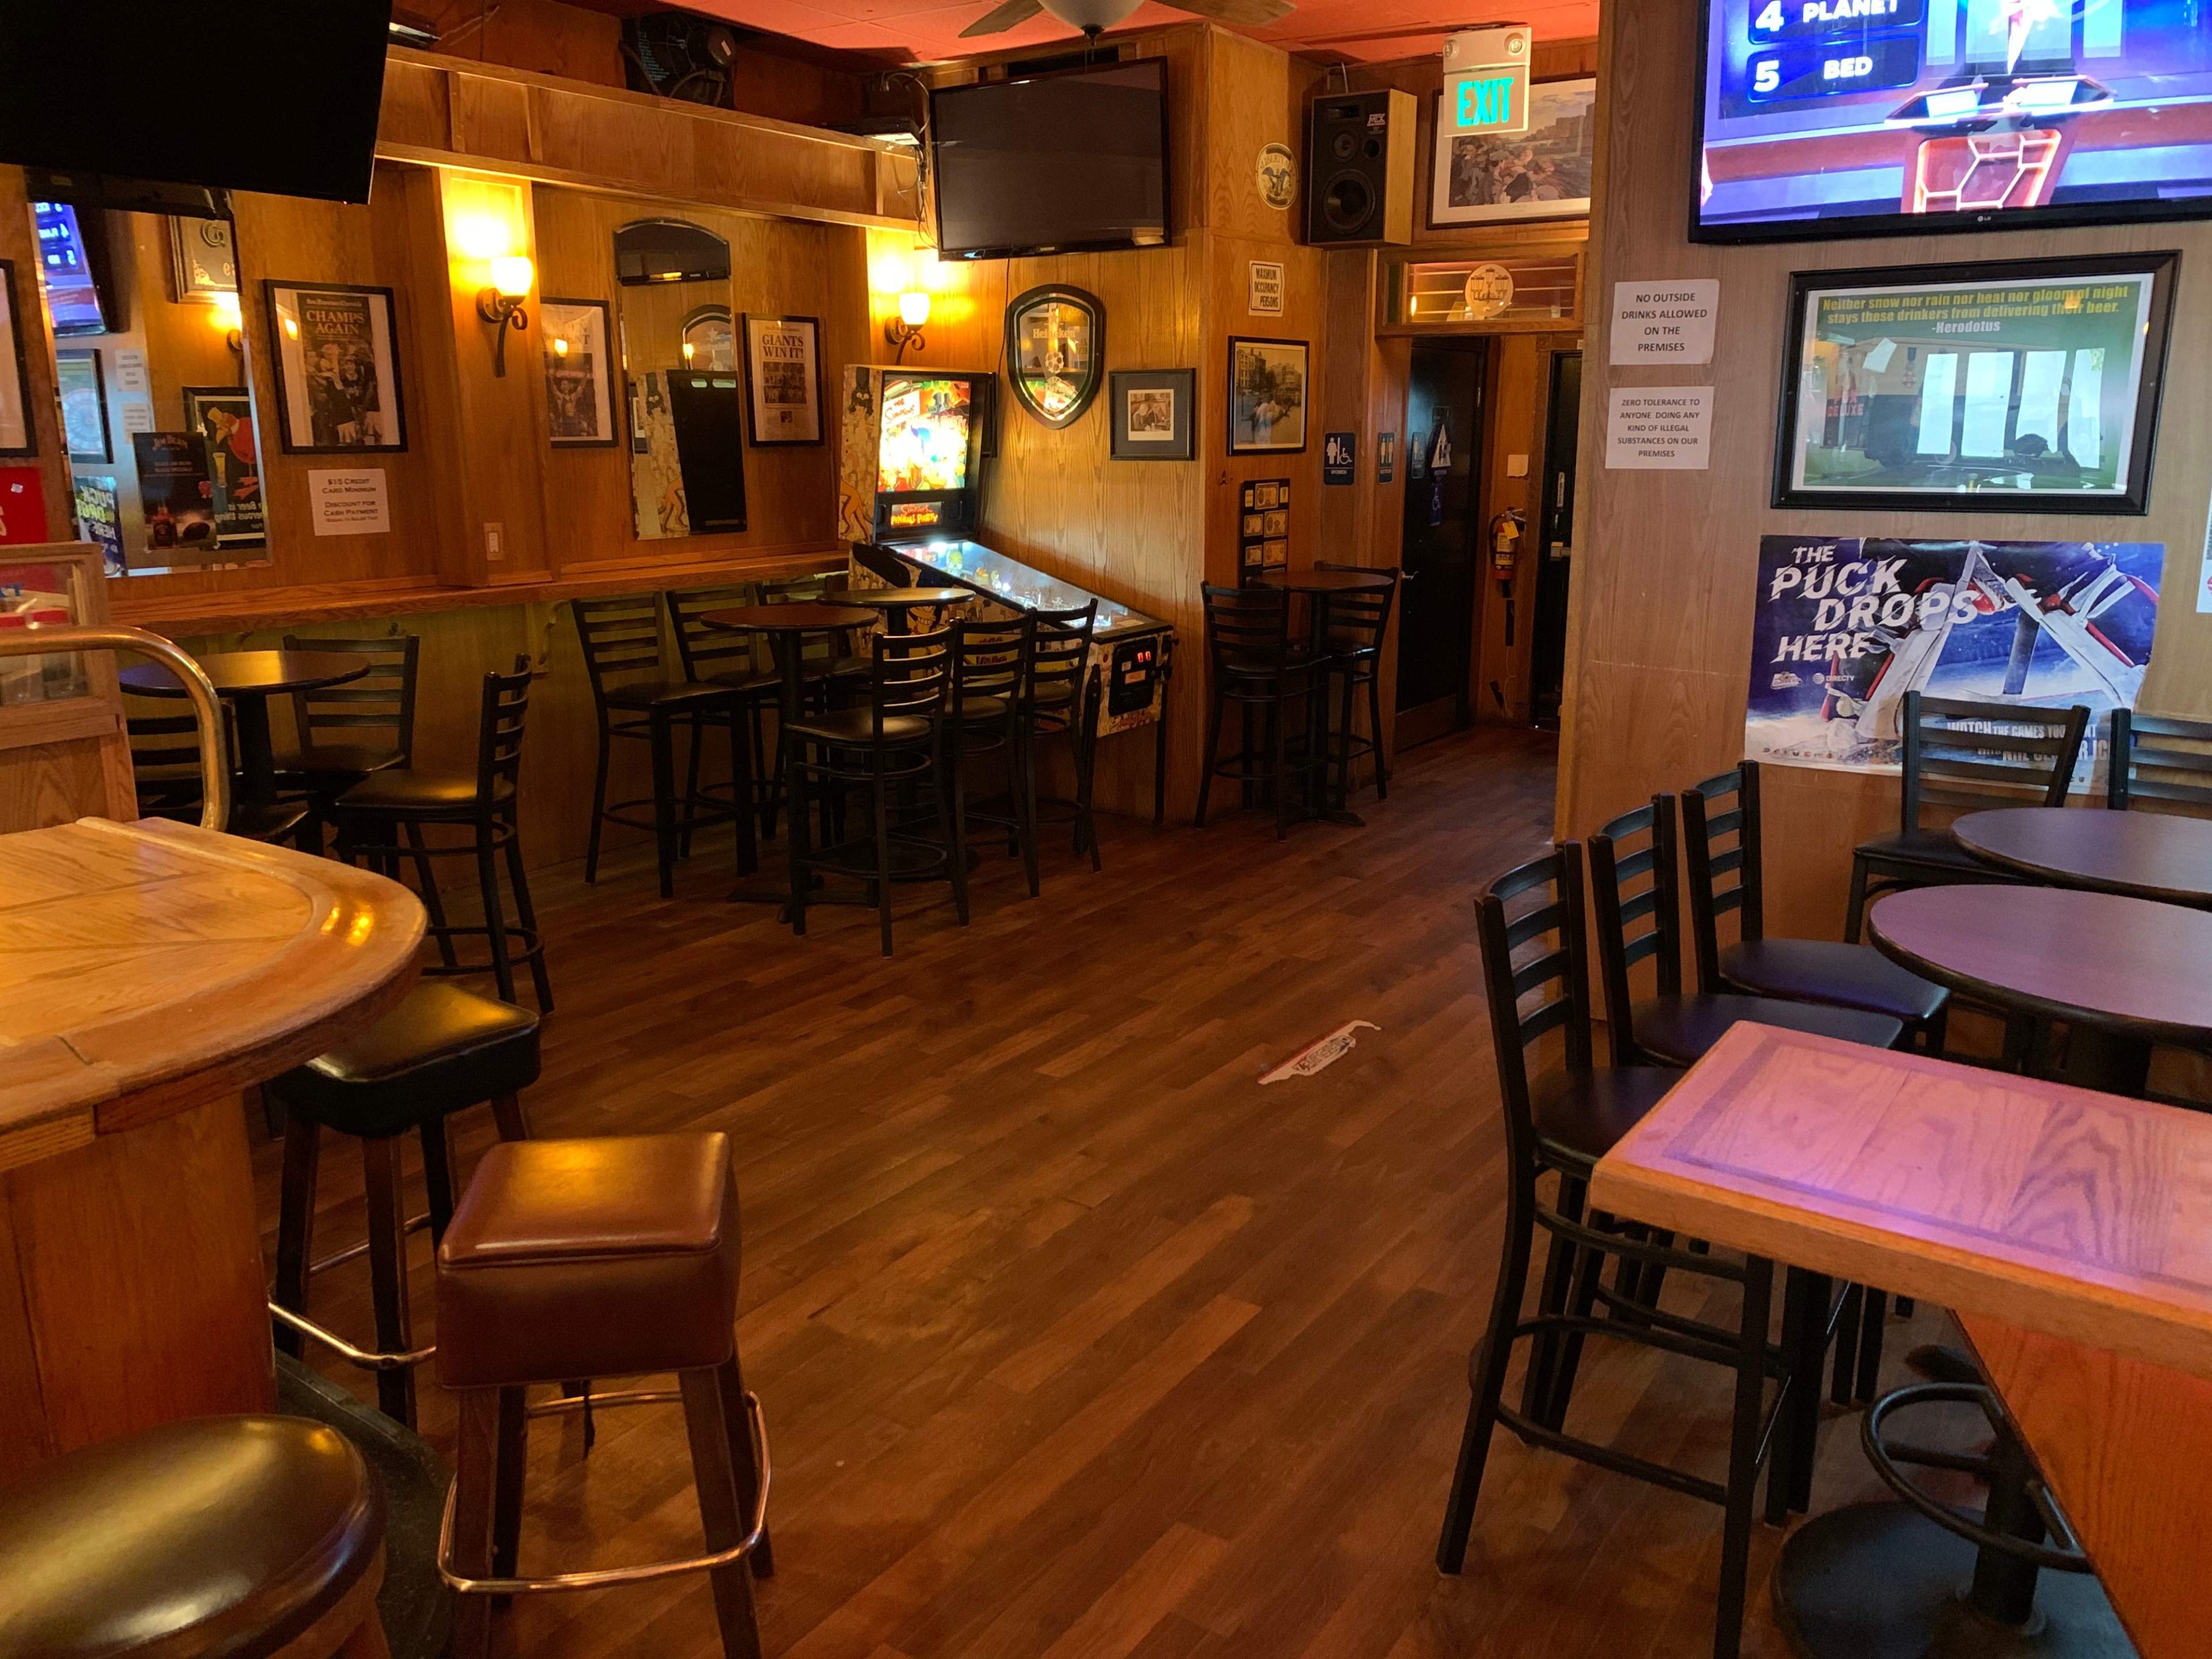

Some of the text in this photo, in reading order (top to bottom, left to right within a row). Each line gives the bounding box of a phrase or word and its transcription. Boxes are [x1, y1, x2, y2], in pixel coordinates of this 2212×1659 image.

[1755, 0, 1898, 32] 4 PLANET
[1753, 56, 1873, 92] 5 BED
[1457, 76, 1514, 127] EXIT
[1254, 281, 1279, 294] OCCUPANCY
[1260, 296, 1279, 308] PERSONS
[1636, 293, 1696, 302] NO OUTSIDE
[1823, 298, 1866, 311] Neither
[1868, 298, 1899, 309] snow
[1902, 296, 1923, 308] nor
[1925, 294, 1950, 306] rain
[1953, 294, 1974, 306] nor
[1976, 292, 2005, 304] heat
[2008, 291, 2030, 302] nor
[2032, 289, 2074, 304] gloom
[2093, 286, 2128, 300] night
[306, 310, 365, 323] CHAMPS
[1622, 309, 1707, 320] DRINKS ALLOWED
[1828, 312, 1858, 325] stays
[1861, 311, 1894, 323] these
[1897, 309, 1948, 321] drinkers
[1952, 307, 1980, 319] from
[1983, 304, 2048, 317] delivering
[2086, 301, 2119, 313] beer.
[315, 323, 359, 335] AGAIN
[1033, 328, 1076, 339] Heineken
[1644, 326, 1680, 335] ON THE
[1931, 320, 2001, 334] -Herodotus
[762, 334, 804, 347] GIANTS
[1638, 343, 1685, 351] PREMISES
[763, 346, 804, 358] WIN IT!
[1791, 545, 1837, 564] THE
[1768, 555, 1908, 603] PUCK
[1811, 589, 1983, 631] DROPS
[1770, 631, 1876, 664] HERE
[2012, 725, 2045, 738] GAMES
[2047, 725, 2067, 738] YOU
